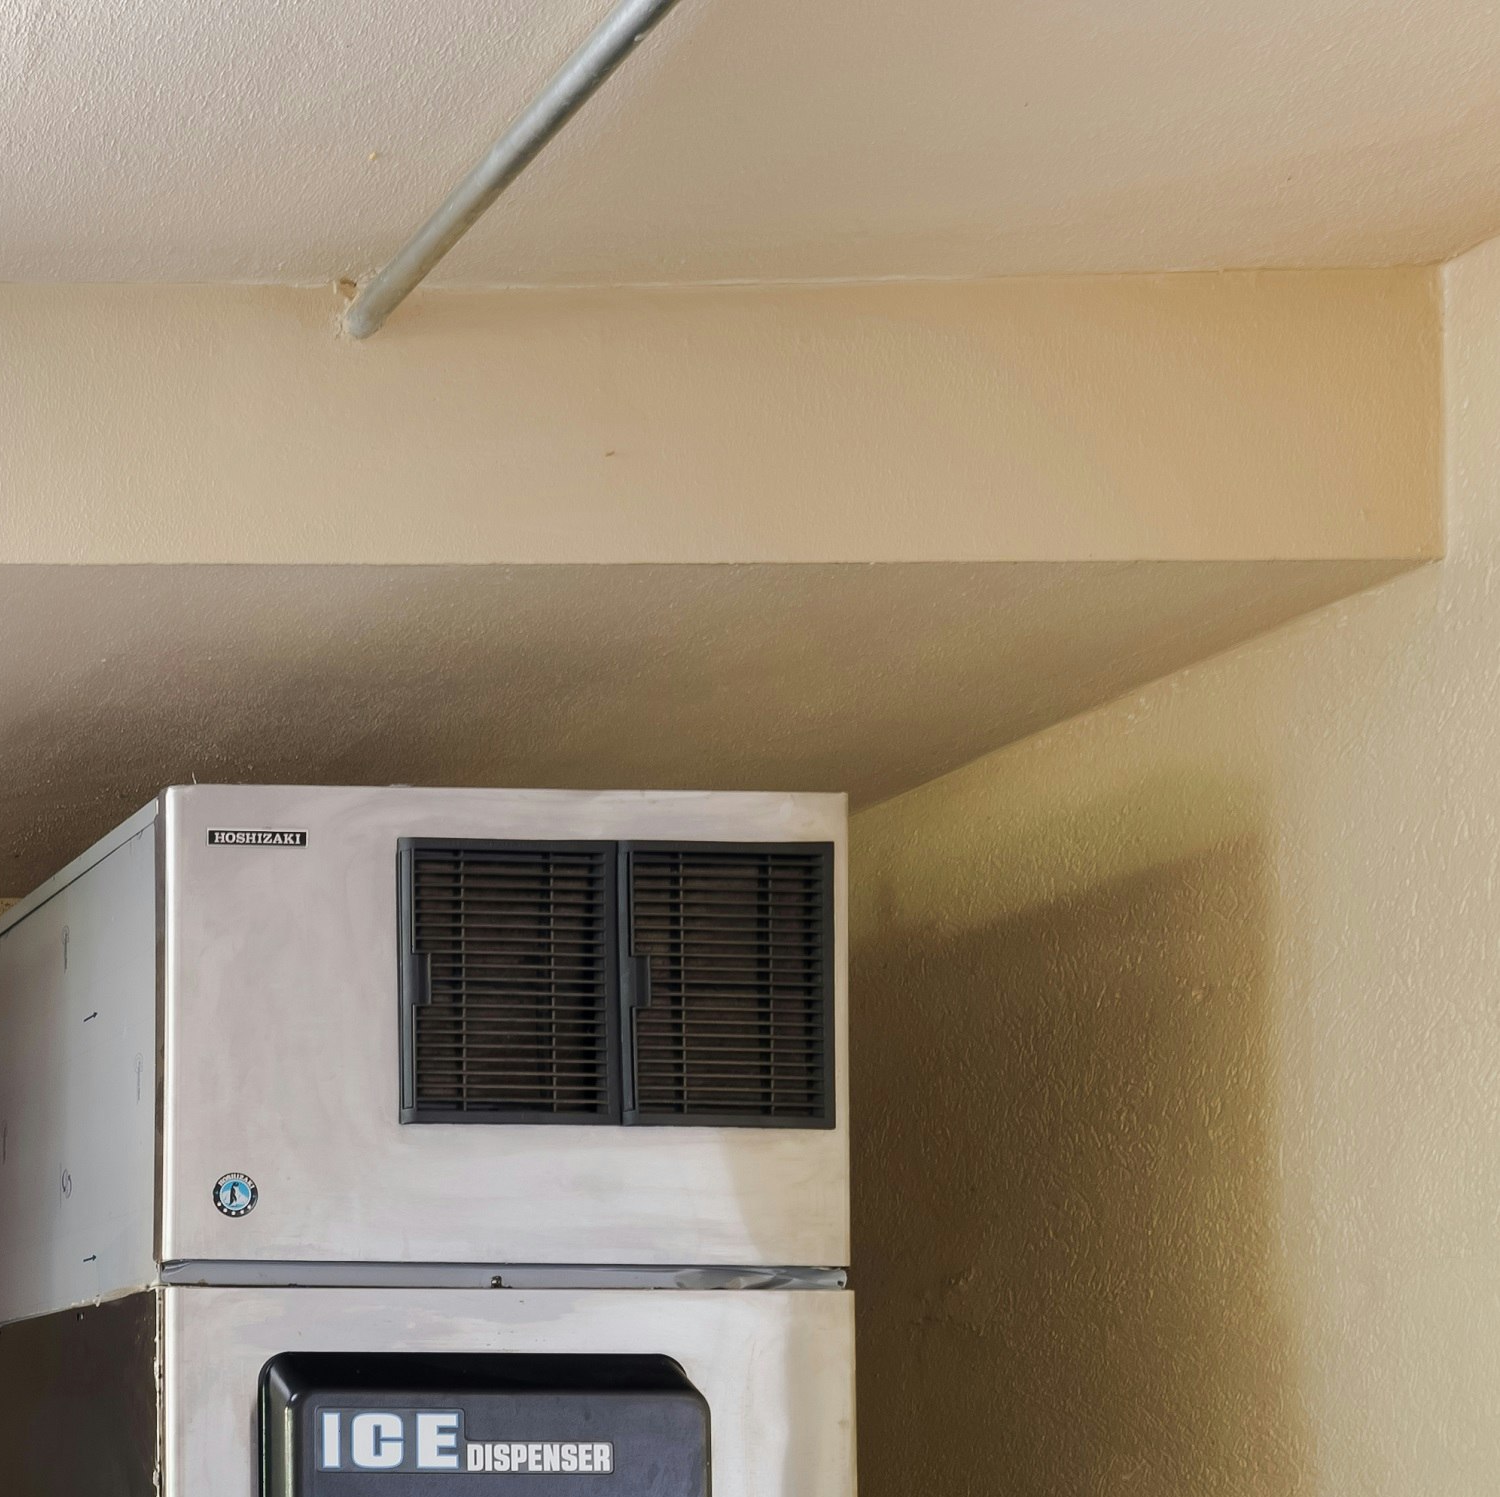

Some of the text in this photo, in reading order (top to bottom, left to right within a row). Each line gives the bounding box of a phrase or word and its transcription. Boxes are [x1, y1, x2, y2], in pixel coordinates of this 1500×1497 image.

[213, 831, 302, 844] HOSHIZAKI
[322, 1411, 611, 1472] ICE DISPENSER
